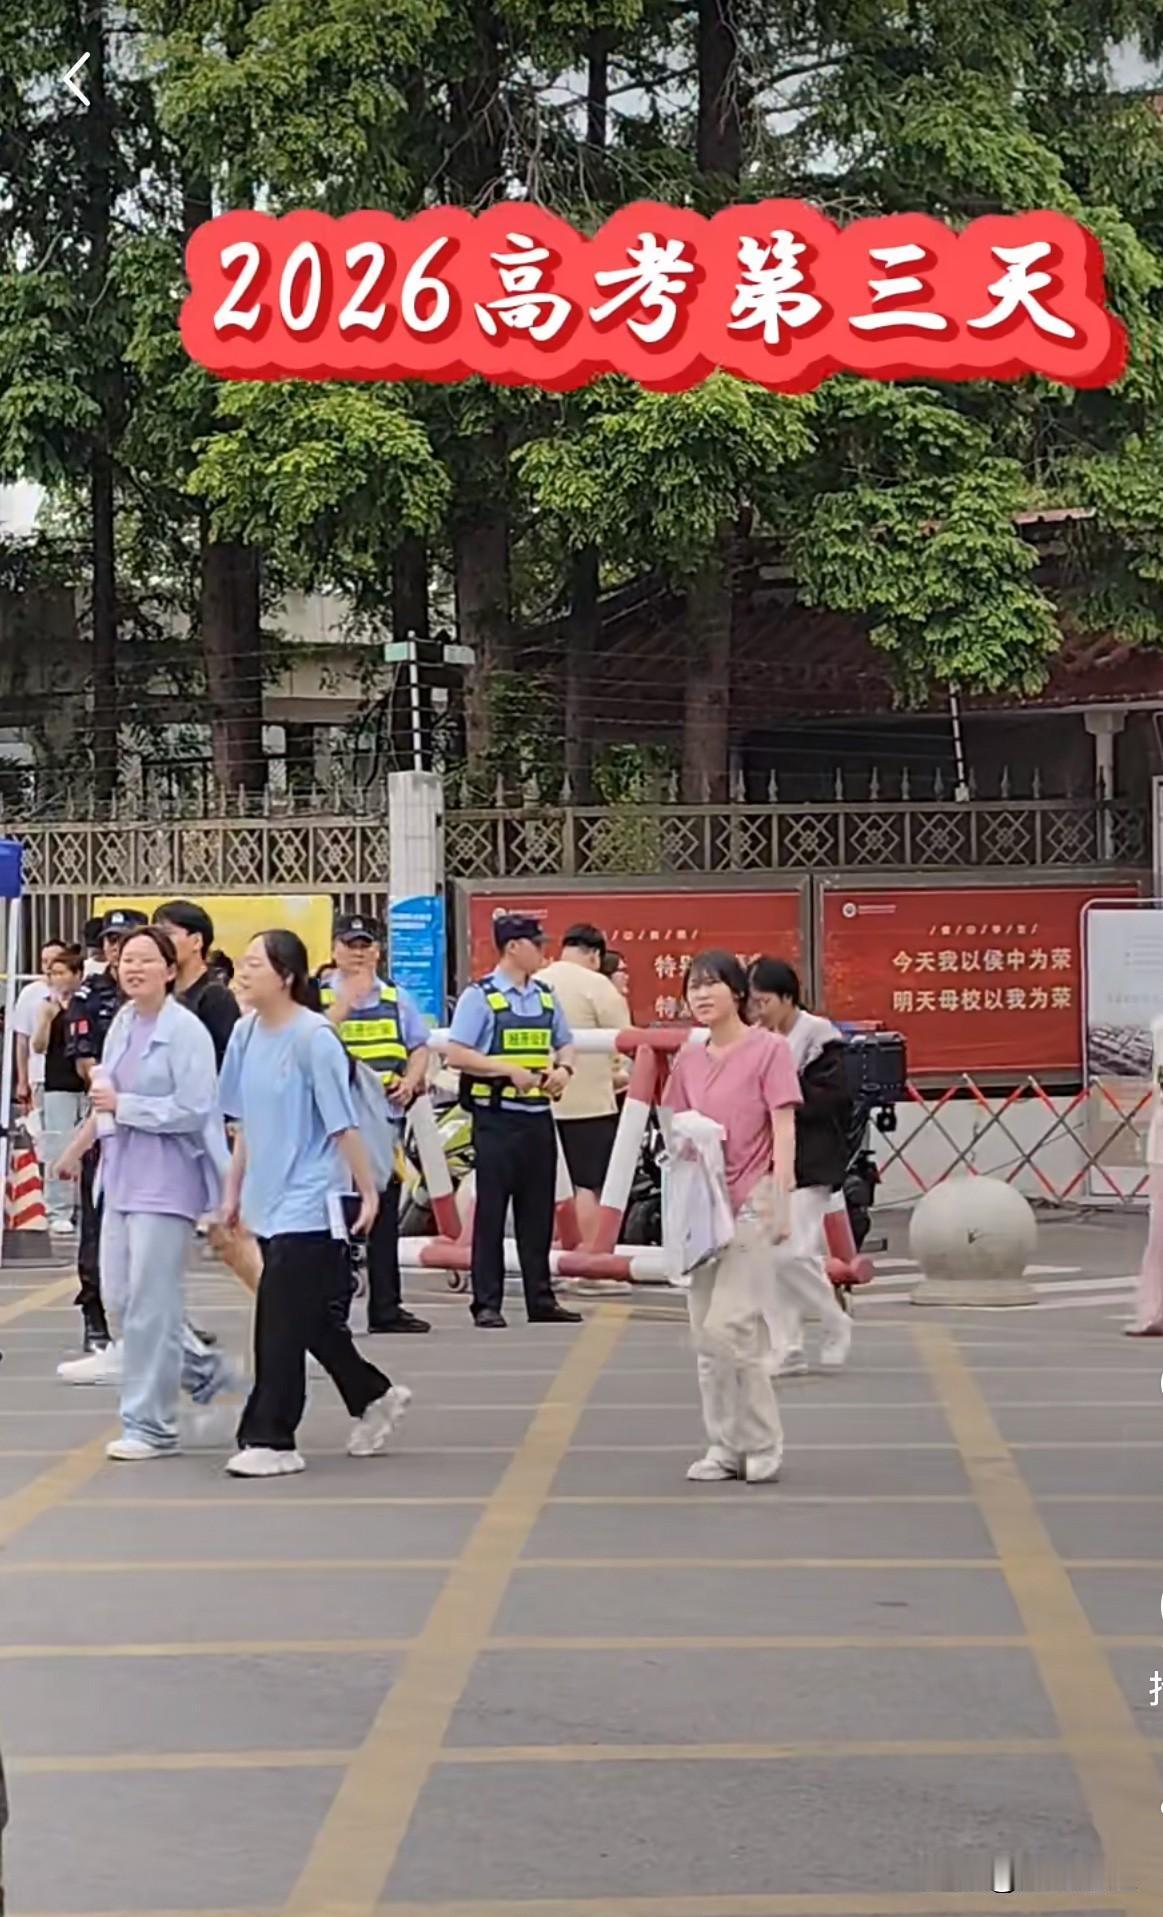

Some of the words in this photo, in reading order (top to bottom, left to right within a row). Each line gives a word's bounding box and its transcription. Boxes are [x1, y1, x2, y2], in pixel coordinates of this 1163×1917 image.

[892, 986, 1072, 1012] 明天母校以我为荣
